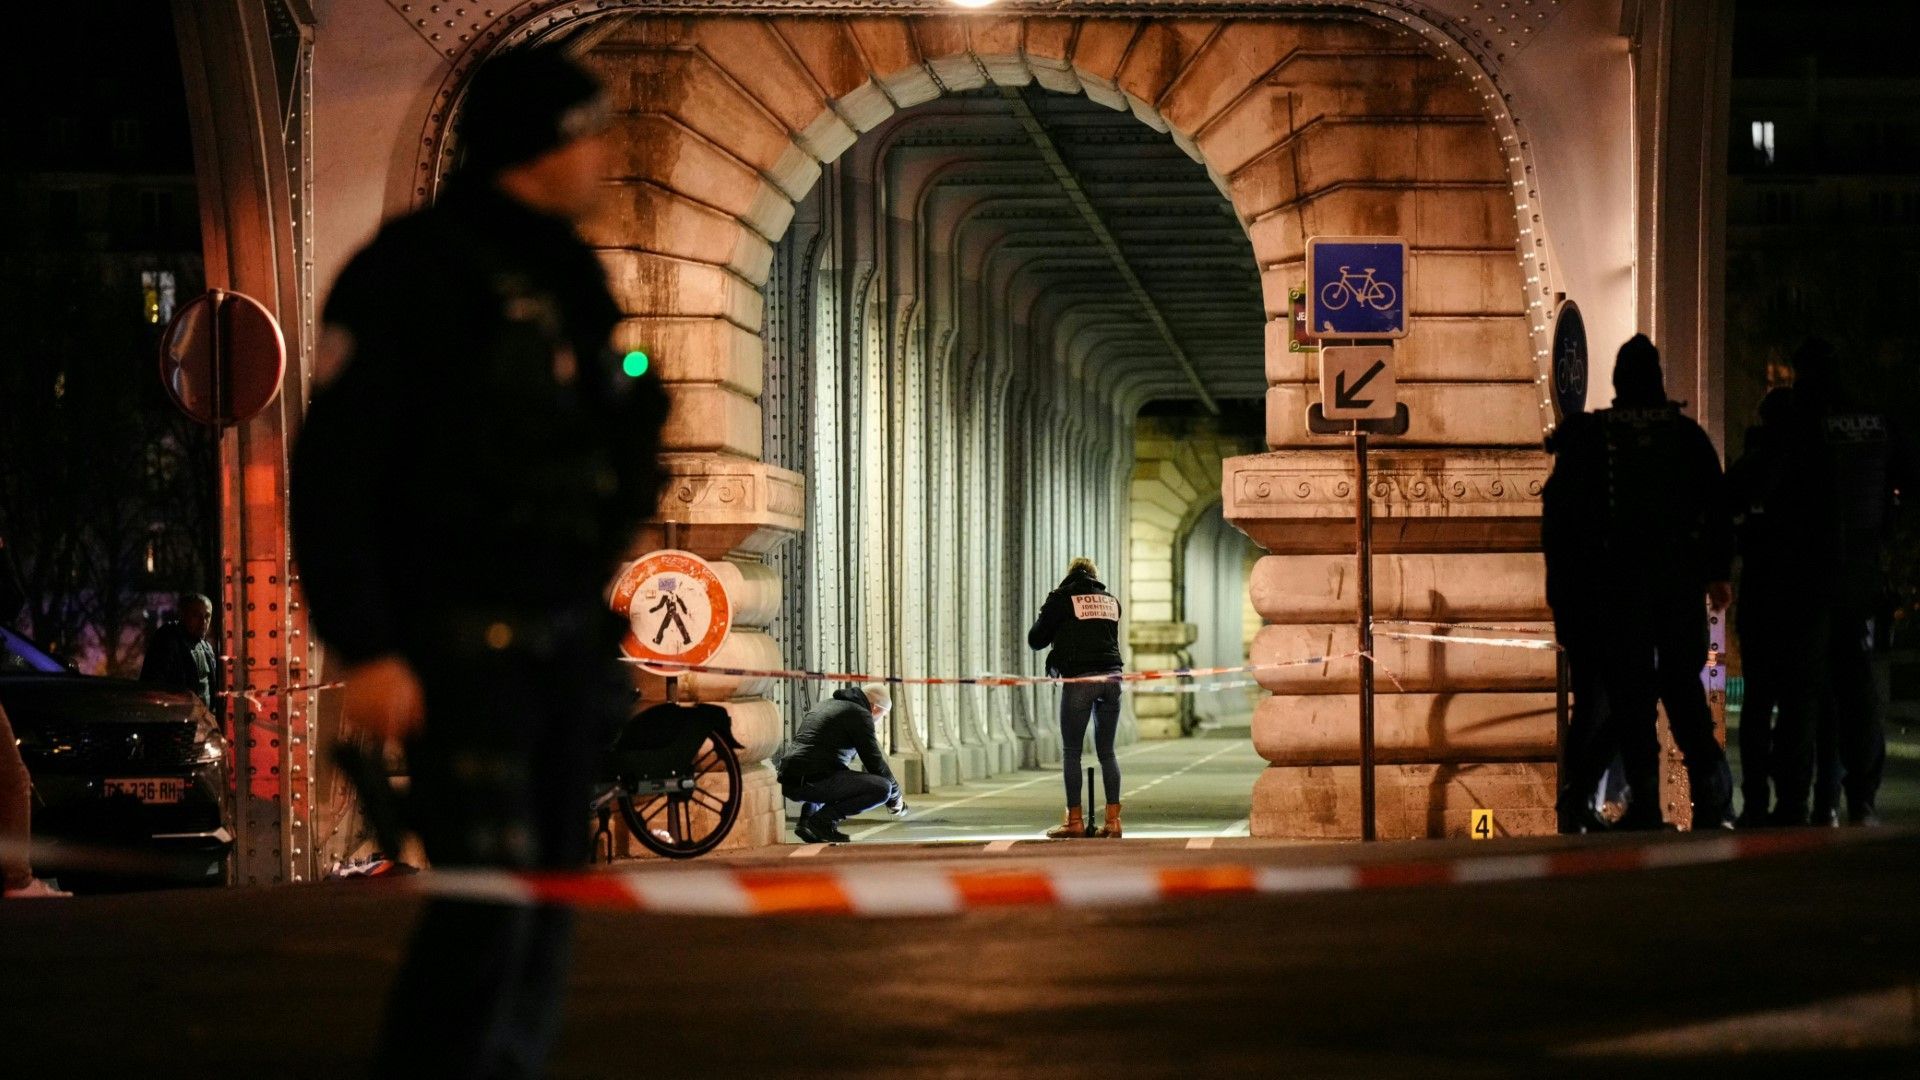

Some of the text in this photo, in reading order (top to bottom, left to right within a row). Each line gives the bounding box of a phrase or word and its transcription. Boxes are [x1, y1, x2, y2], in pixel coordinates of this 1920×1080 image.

[1607, 408, 1672, 422] POLICE
[1827, 415, 1882, 433] POLICE
[1475, 814, 1490, 839] 4
